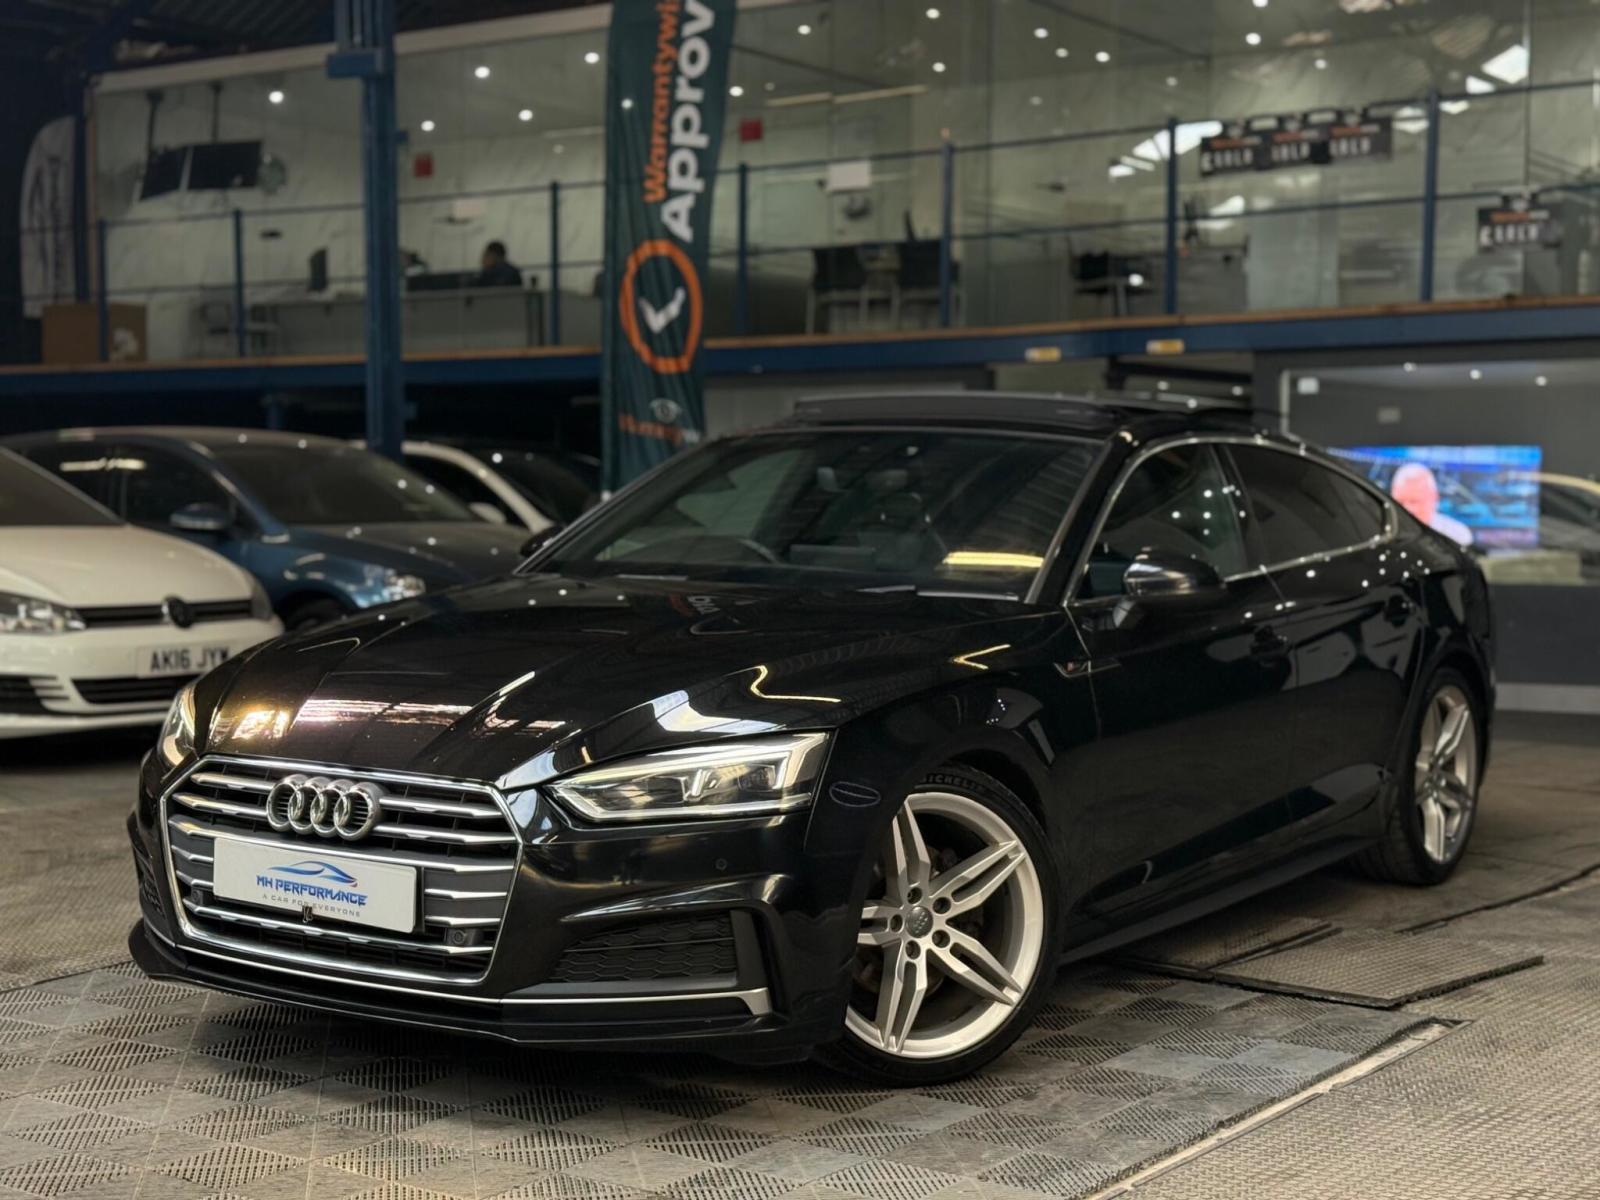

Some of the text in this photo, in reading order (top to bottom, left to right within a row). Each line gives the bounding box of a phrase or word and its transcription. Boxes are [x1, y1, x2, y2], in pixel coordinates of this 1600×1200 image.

[643, 0, 680, 203] Warrantywi
[150, 648, 191, 672] AK16
[256, 875, 368, 906] MH PERFORMANCE
[270, 895, 289, 903] CAR
[312, 903, 361, 917] EVERYONE
